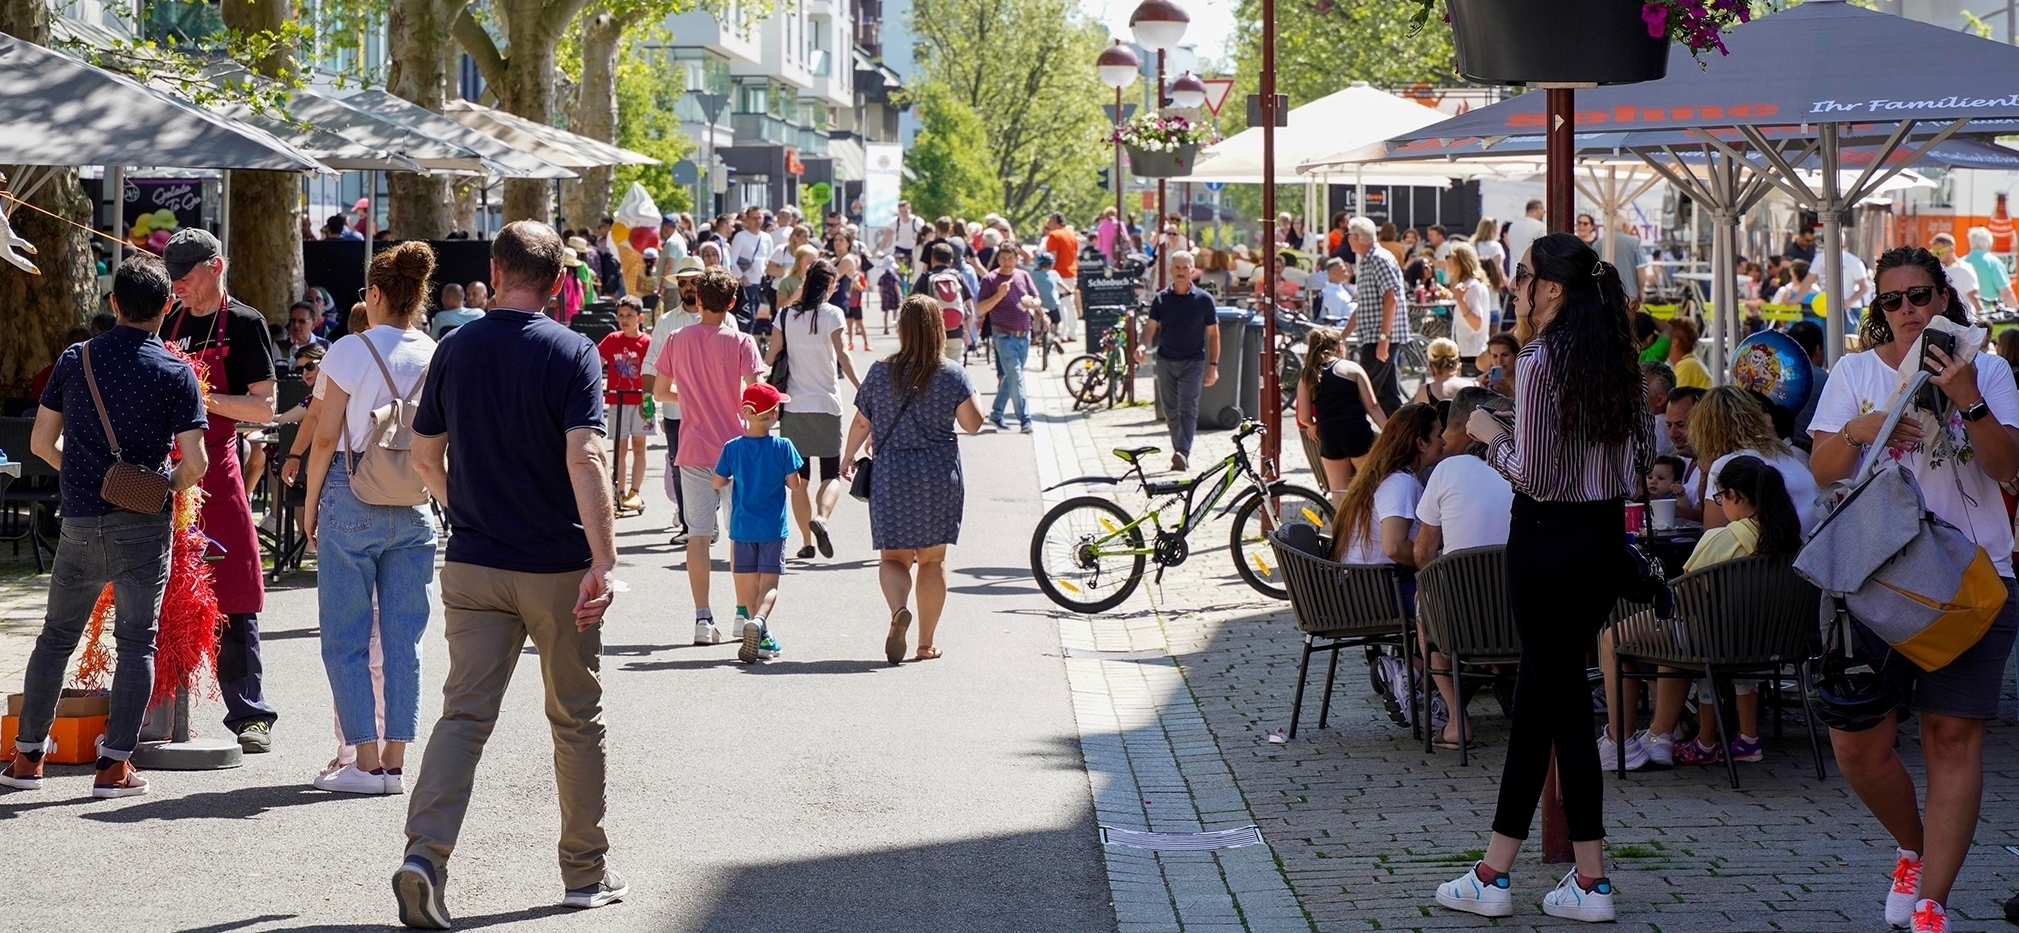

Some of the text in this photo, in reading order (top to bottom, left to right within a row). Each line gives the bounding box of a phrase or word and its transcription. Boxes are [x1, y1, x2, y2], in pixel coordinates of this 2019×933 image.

[1809, 100, 1863, 113] Ihr
[165, 193, 201, 212] To Go
[1087, 276, 1130, 288] Schönbuch
